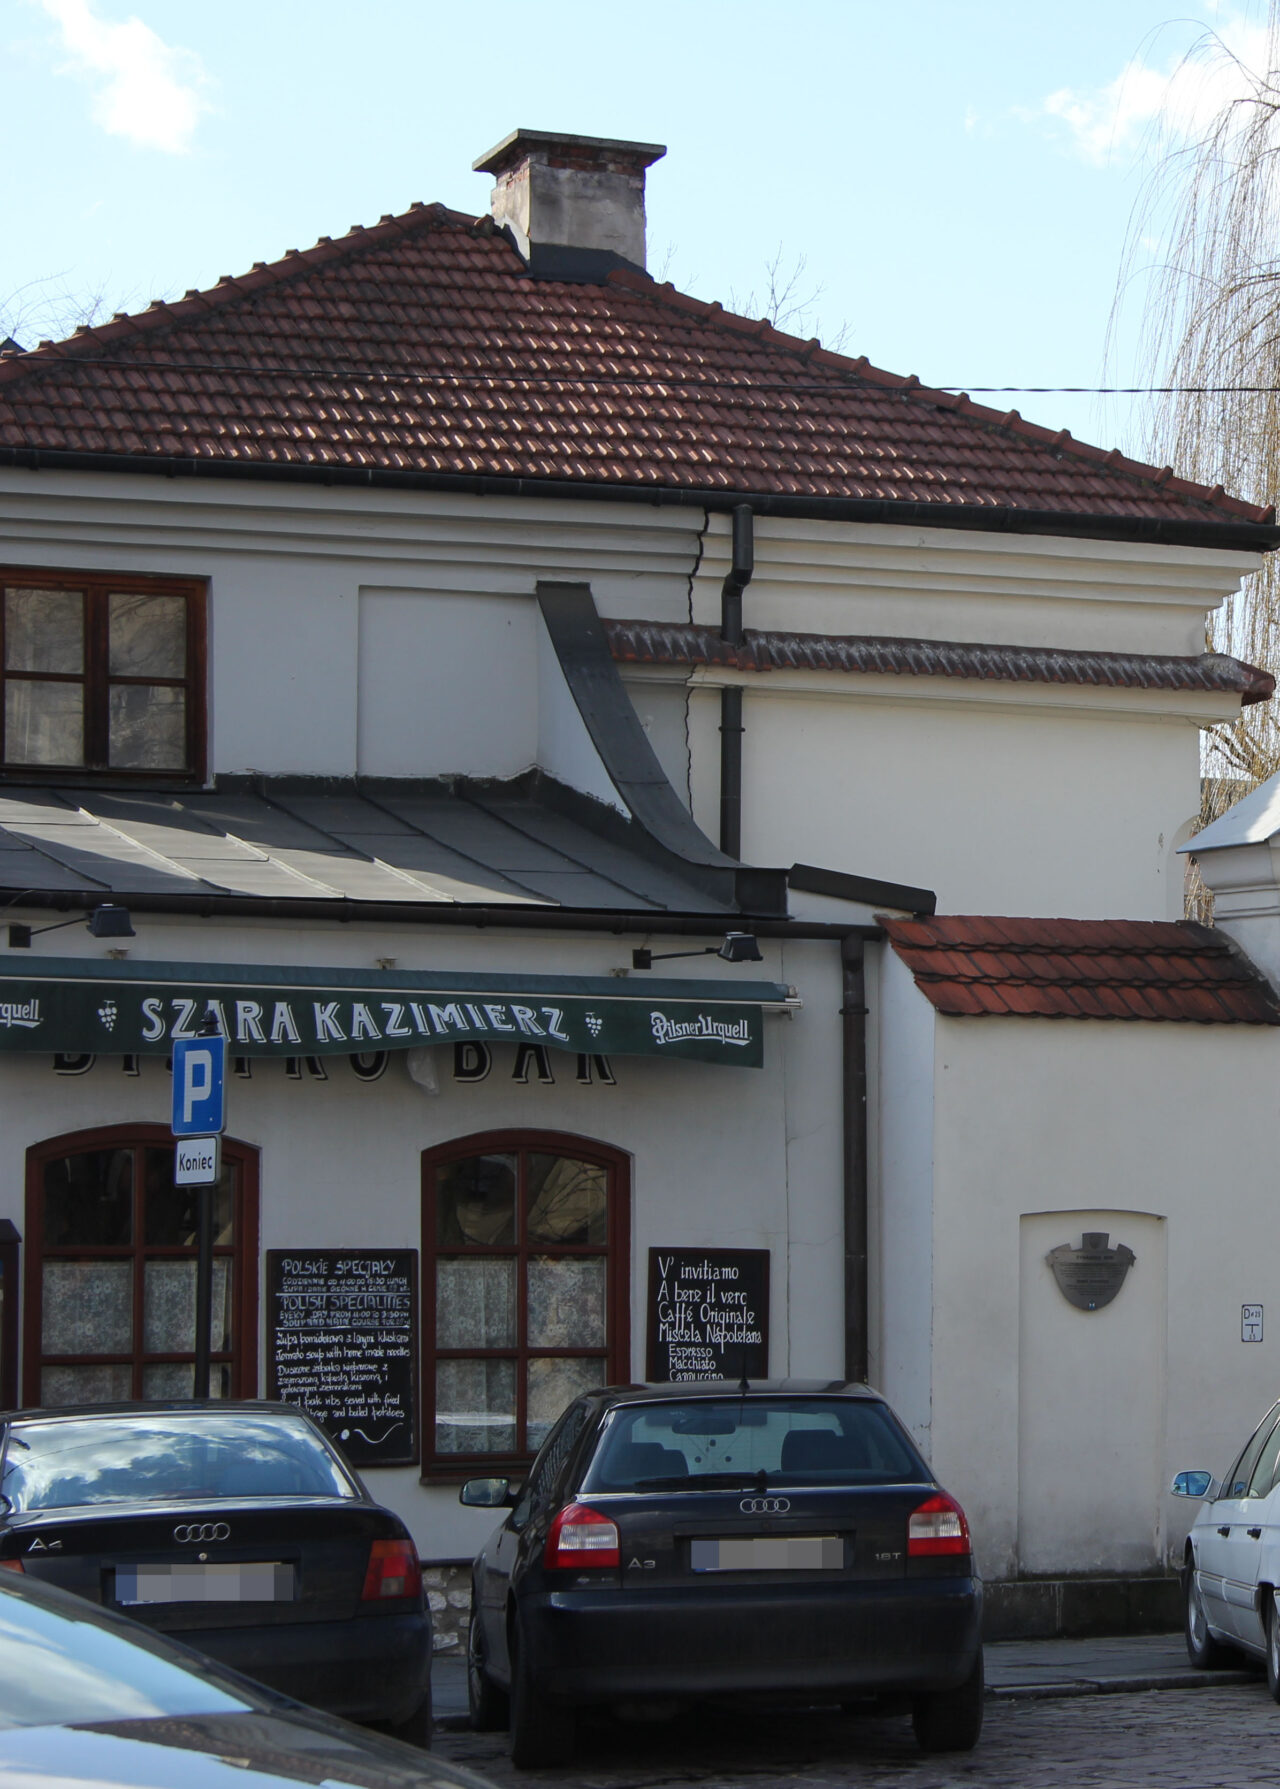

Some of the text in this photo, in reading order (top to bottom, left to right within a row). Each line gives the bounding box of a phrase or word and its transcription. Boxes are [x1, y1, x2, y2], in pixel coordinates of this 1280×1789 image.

[142, 998, 569, 1042] SZARA KAZIMIERZ
[650, 1011, 748, 1045] Pilsner Urquell
[183, 1049, 212, 1123] P
[179, 1152, 212, 1172] Koniec
[681, 1259, 739, 1280] invitiamo
[657, 1280, 669, 1301] A
[674, 1281, 702, 1302] bere
[706, 1282, 716, 1304] il
[281, 1295, 326, 1310] POLISH
[280, 1311, 305, 1319] EVERY
[312, 1311, 328, 1319] DAY
[700, 1303, 755, 1336] Originale
[659, 1322, 702, 1342] Miscela
[305, 1348, 325, 1362] soup
[668, 1343, 713, 1360] Espresso
[669, 1357, 716, 1371] Macchiato
[325, 1394, 341, 1406] ribs
[332, 1406, 346, 1418] and
[371, 1405, 405, 1421] potatoes
[27, 1537, 63, 1552] A4
[628, 1557, 656, 1570] A3
